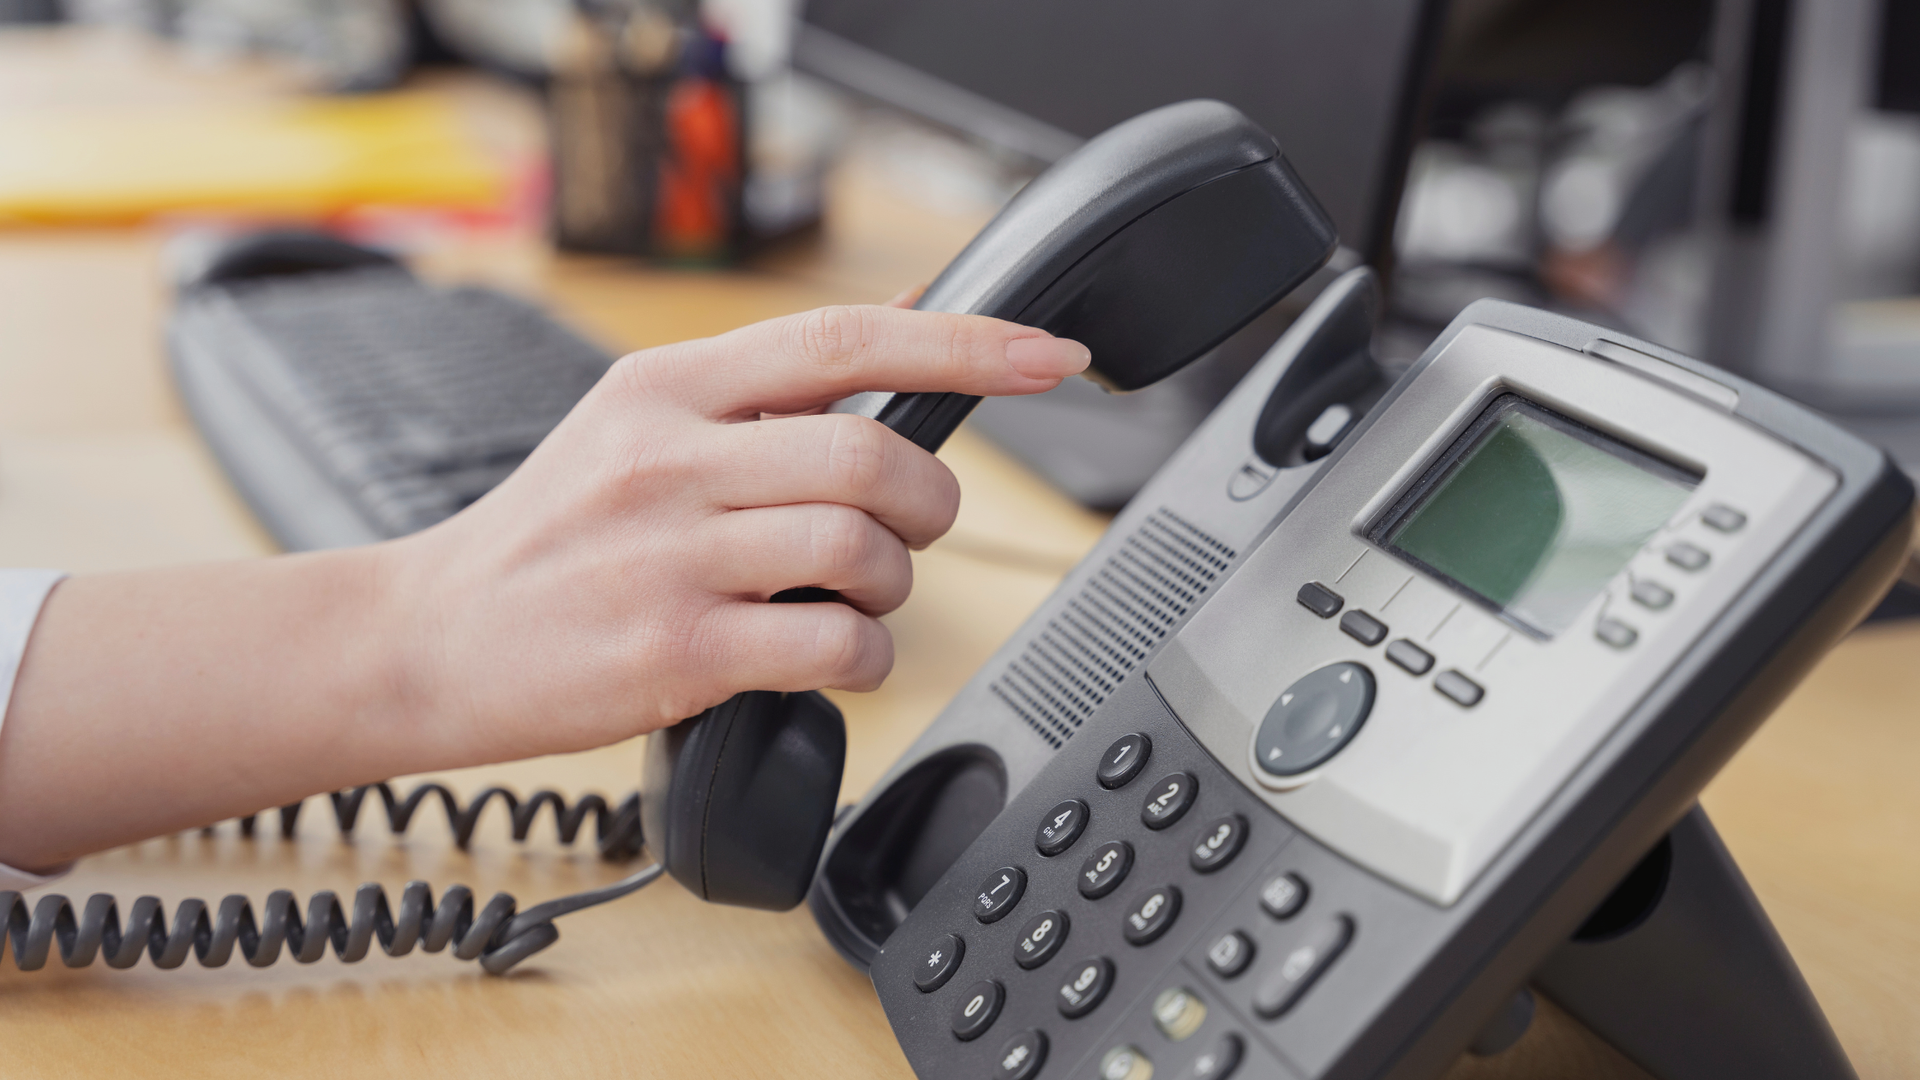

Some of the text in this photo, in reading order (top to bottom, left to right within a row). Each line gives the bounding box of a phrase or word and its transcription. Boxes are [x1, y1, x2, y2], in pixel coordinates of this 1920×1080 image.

[1113, 744, 1131, 764] 1
[1157, 782, 1179, 806] 2
[1054, 809, 1072, 829] 4
[1043, 826, 1056, 839] GHI
[1207, 824, 1231, 850] 3
[1096, 849, 1118, 872] 5
[991, 874, 1011, 895] 7
[977, 892, 994, 909] PQRS
[1141, 893, 1165, 919] 6
[1032, 919, 1053, 942] 8
[1073, 965, 1098, 992] 9
[964, 995, 985, 1017] 0
